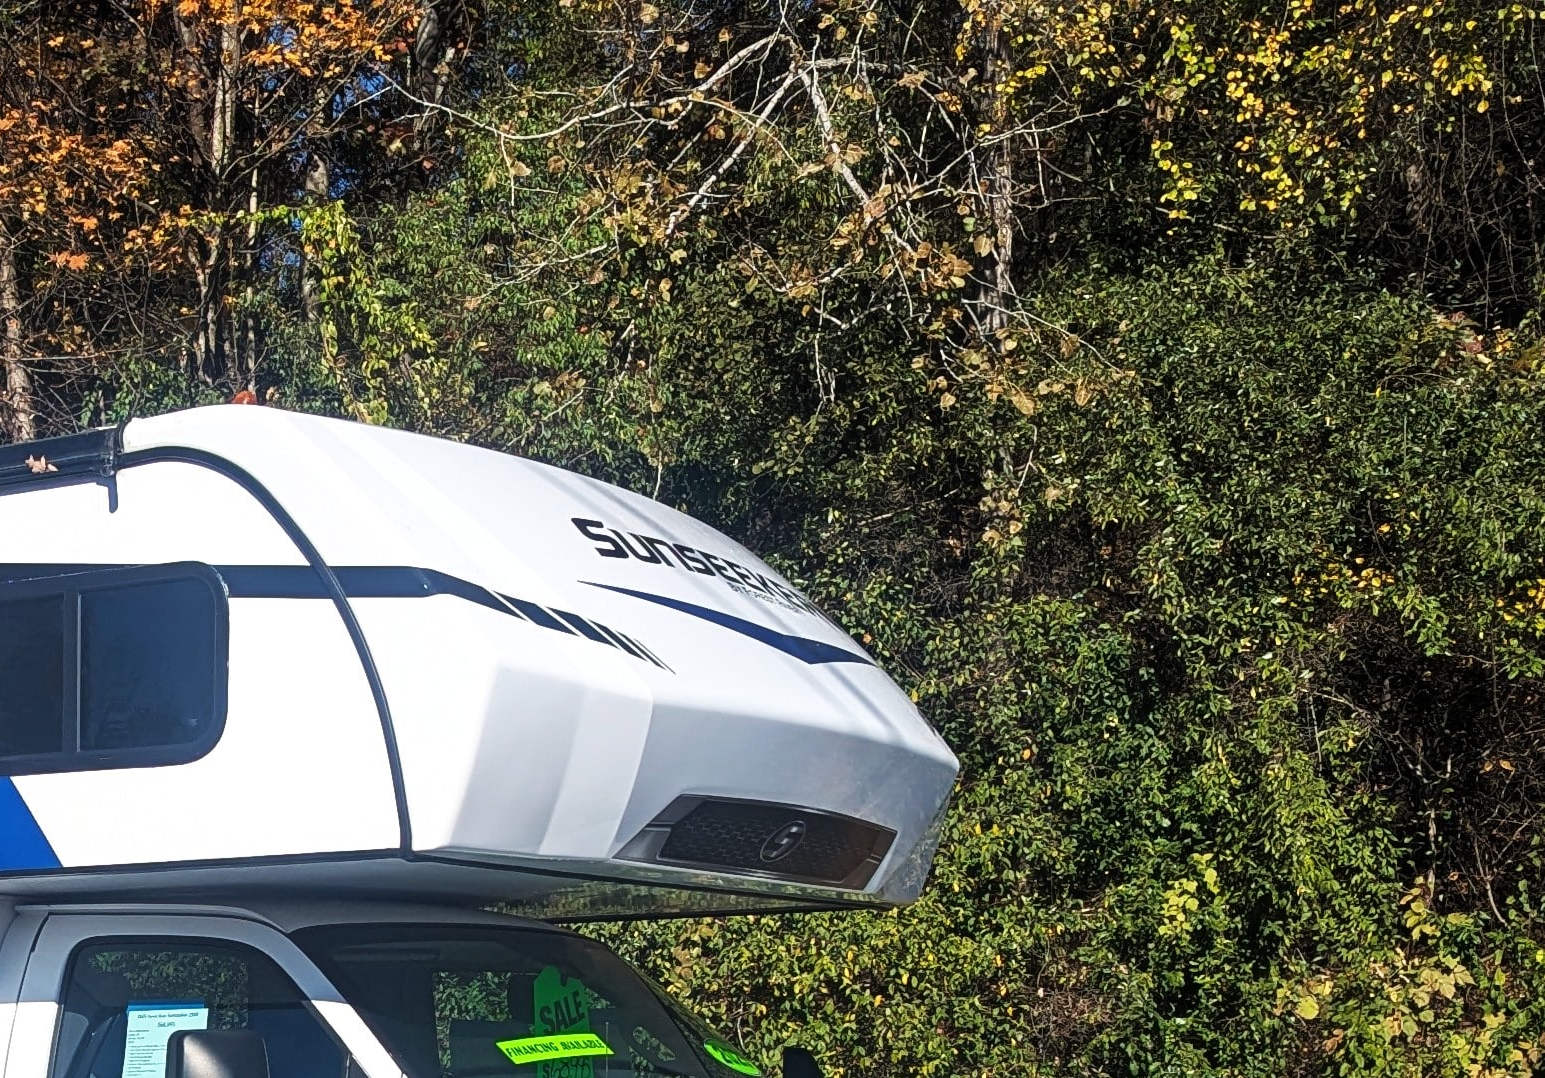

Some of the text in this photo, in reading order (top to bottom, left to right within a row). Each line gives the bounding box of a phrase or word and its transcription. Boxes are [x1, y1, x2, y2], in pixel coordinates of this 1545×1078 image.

[539, 989, 586, 1035] SALE
[505, 1039, 606, 1058] FINANCING AVAILABLE
